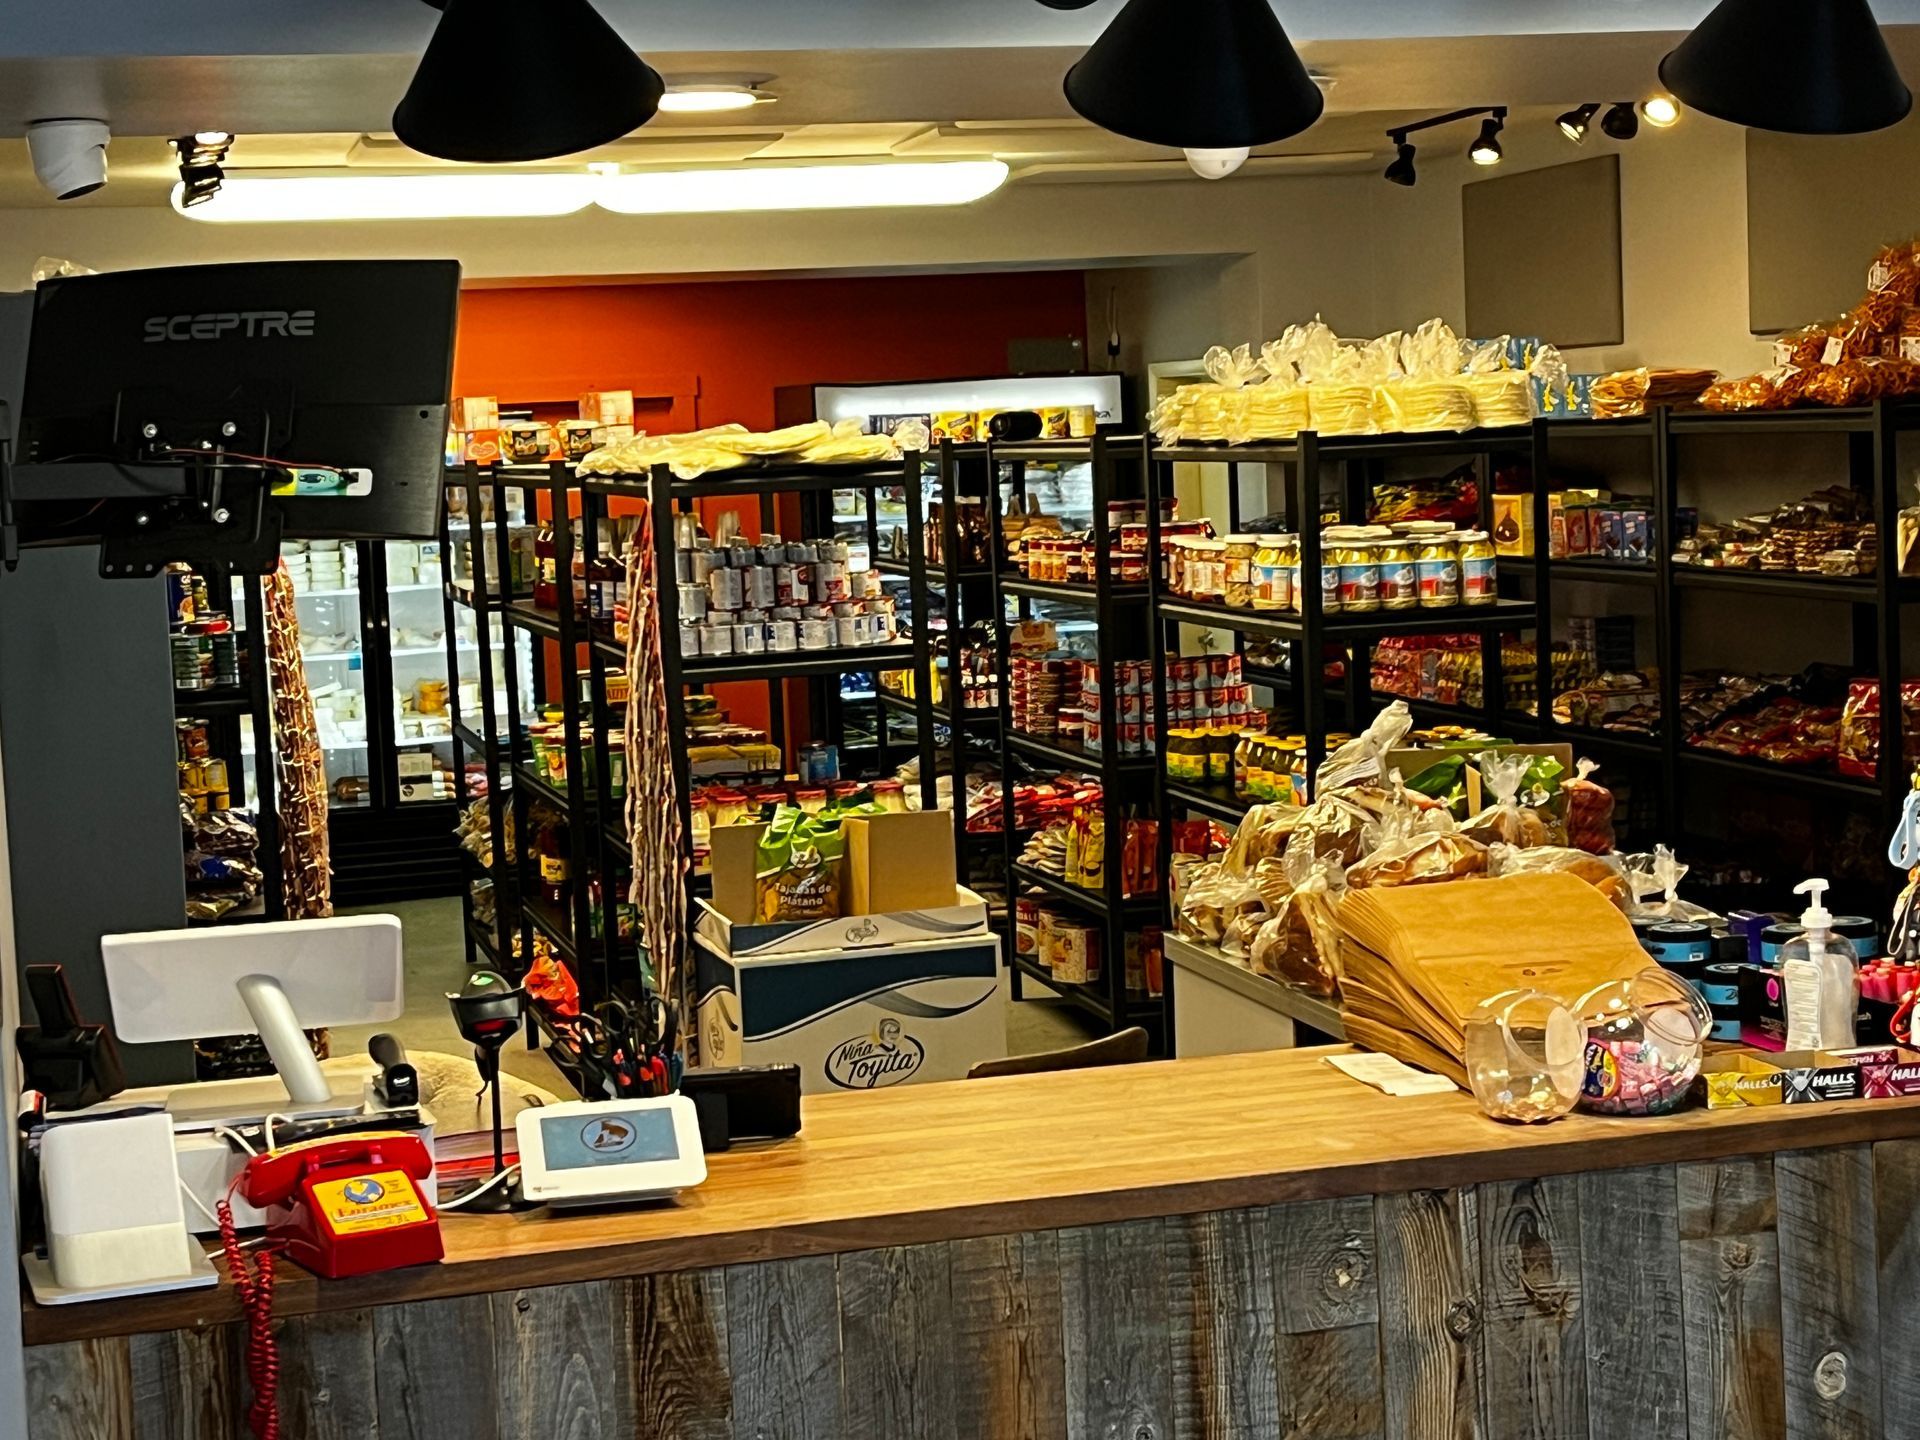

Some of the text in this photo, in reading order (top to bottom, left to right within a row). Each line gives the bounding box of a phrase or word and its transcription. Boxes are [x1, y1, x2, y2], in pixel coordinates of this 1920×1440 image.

[144, 310, 316, 343] SCEPTRE
[836, 1040, 874, 1069] Niña
[848, 1050, 915, 1088] Toyita
[1733, 1079, 1769, 1090] HALLS
[1812, 1073, 1856, 1087] HALLS
